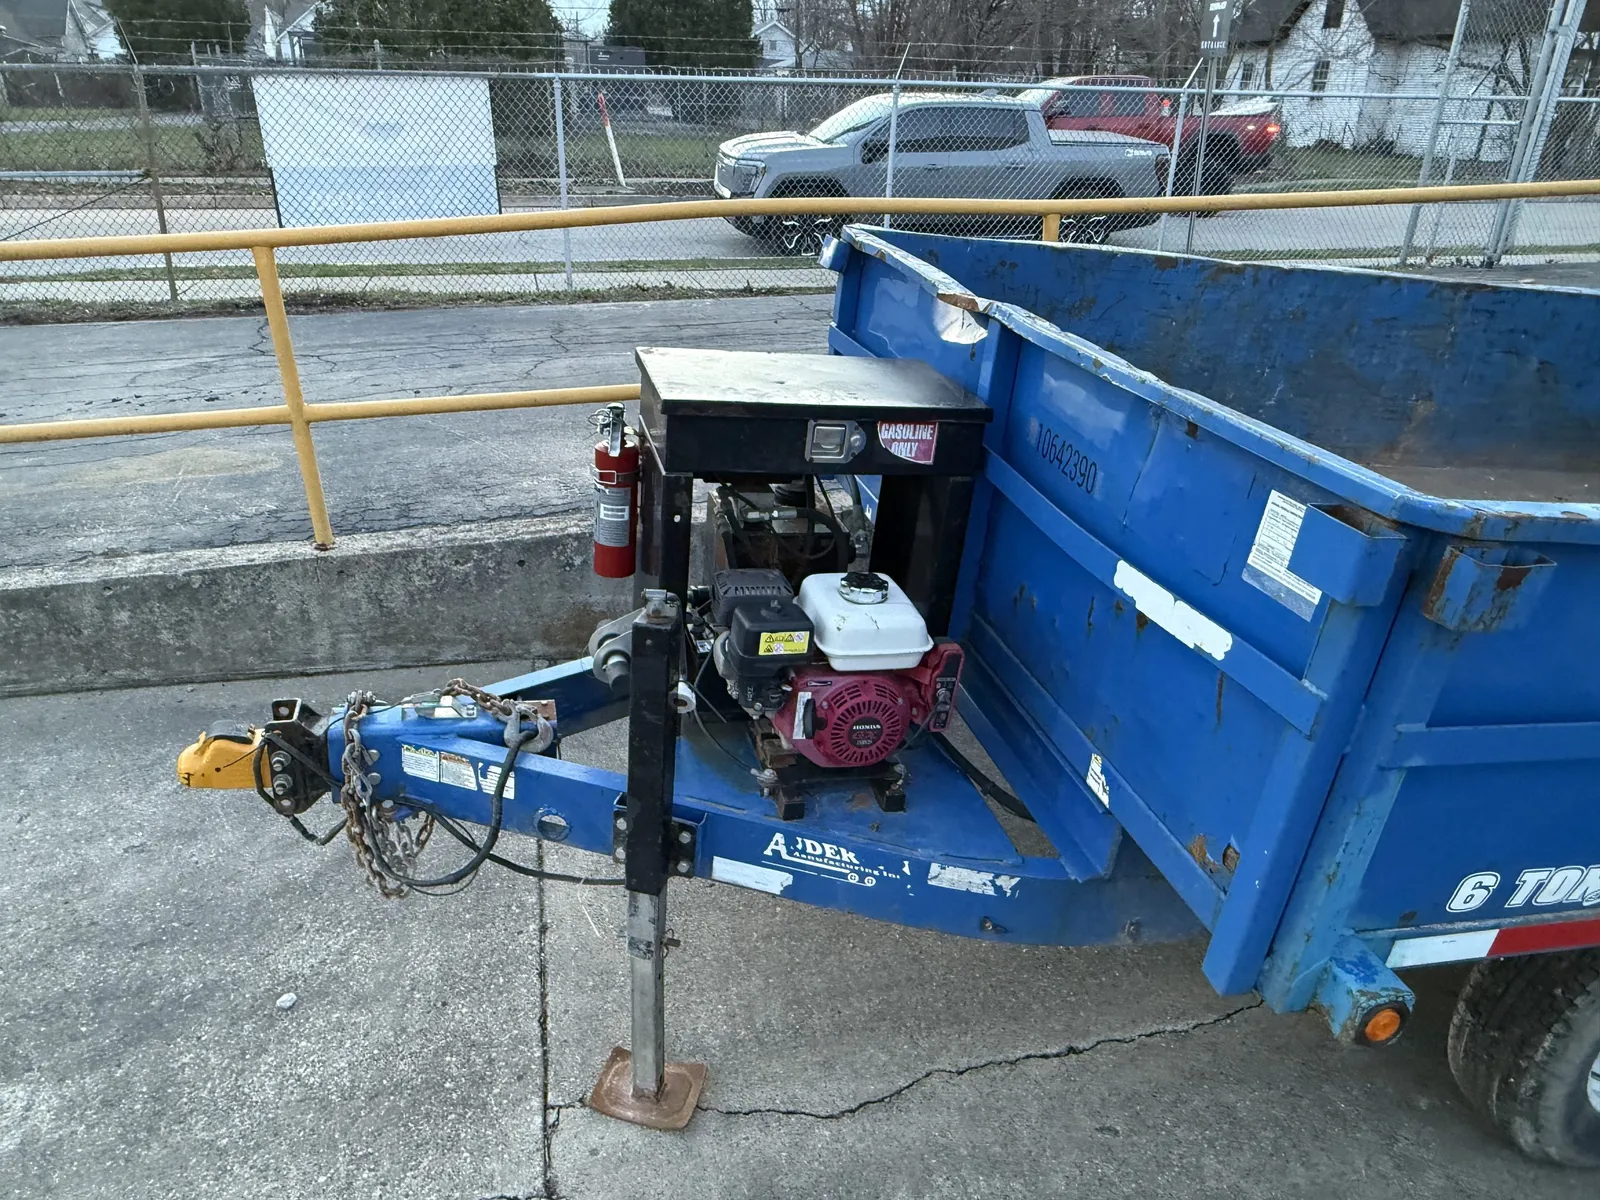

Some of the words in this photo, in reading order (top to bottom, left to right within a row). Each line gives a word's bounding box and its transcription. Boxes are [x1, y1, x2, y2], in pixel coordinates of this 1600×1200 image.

[881, 423, 934, 440] GASOLINE
[891, 442, 918, 458] ONLY
[1036, 423, 1097, 494] 10642390
[1446, 871, 1501, 913] 6
